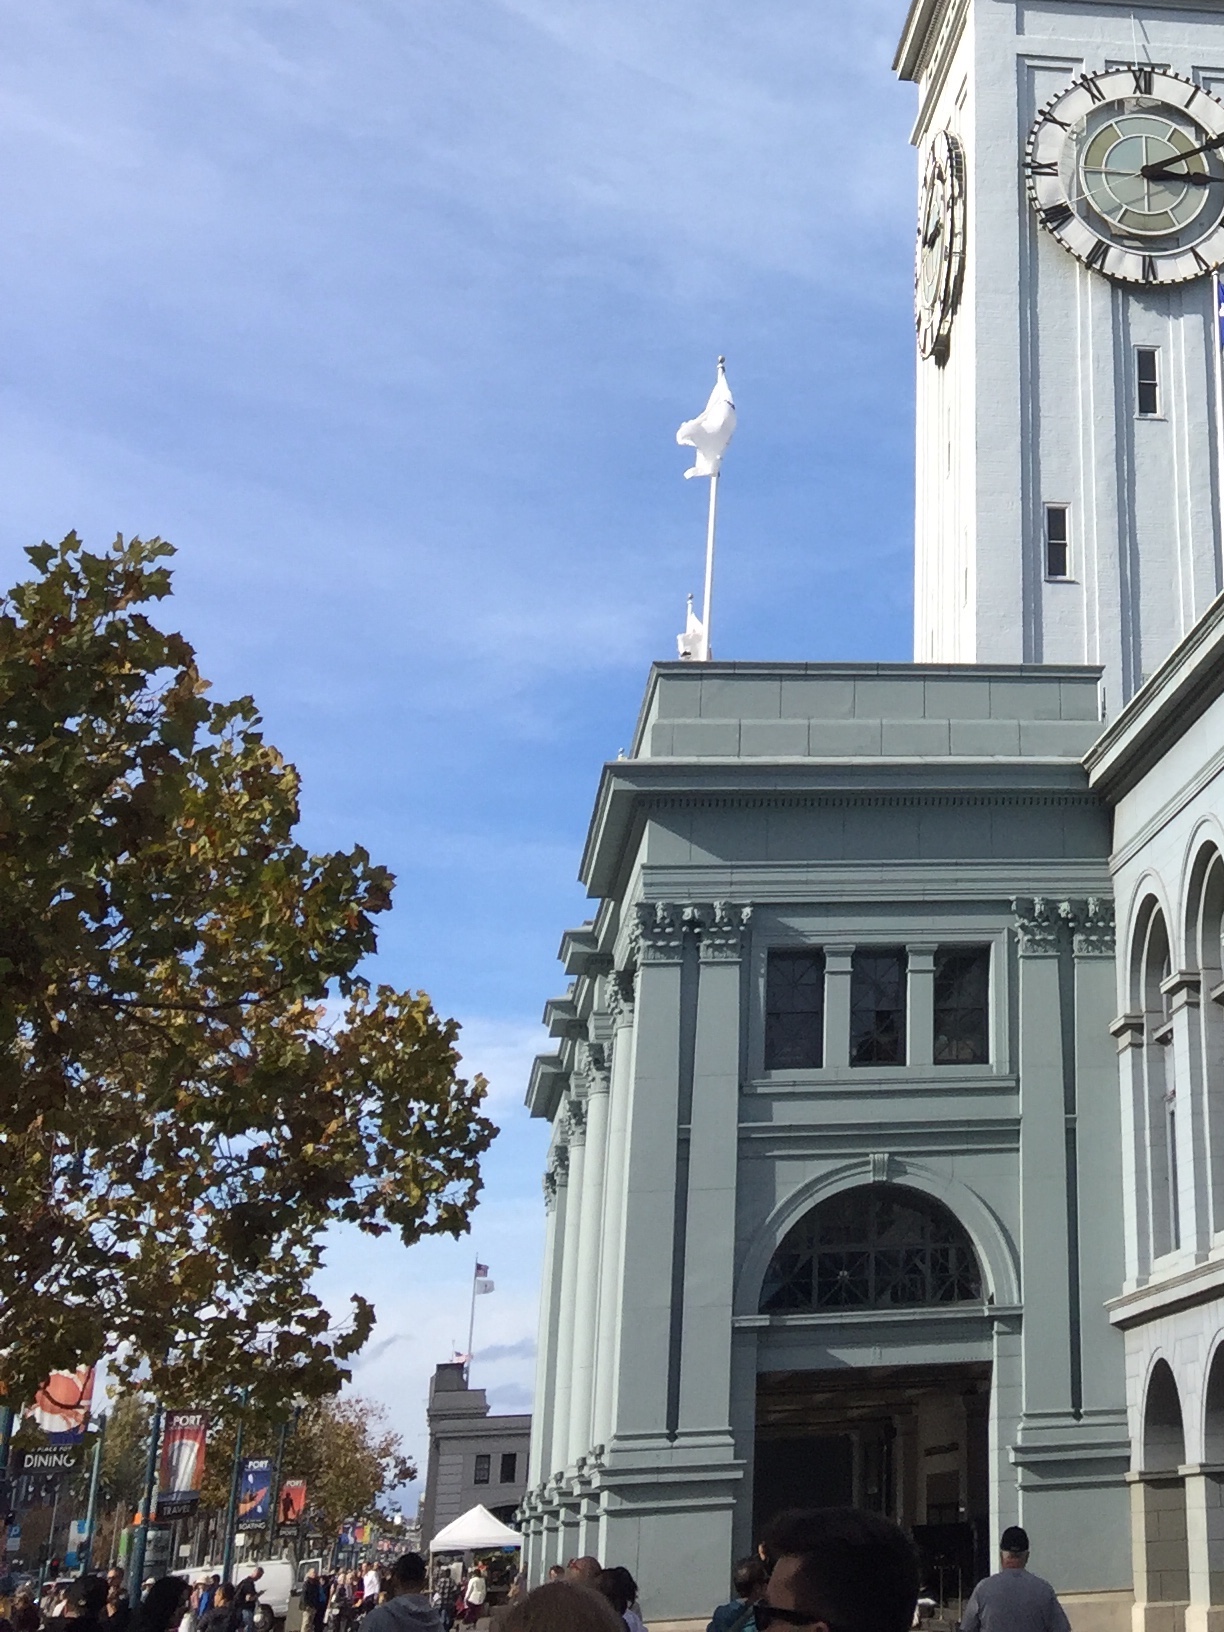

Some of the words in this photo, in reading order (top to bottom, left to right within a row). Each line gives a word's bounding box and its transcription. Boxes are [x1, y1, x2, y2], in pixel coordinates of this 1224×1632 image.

[172, 1414, 202, 1427] PORT
[24, 1453, 76, 1468] DINING
[247, 1459, 269, 1470] PORT
